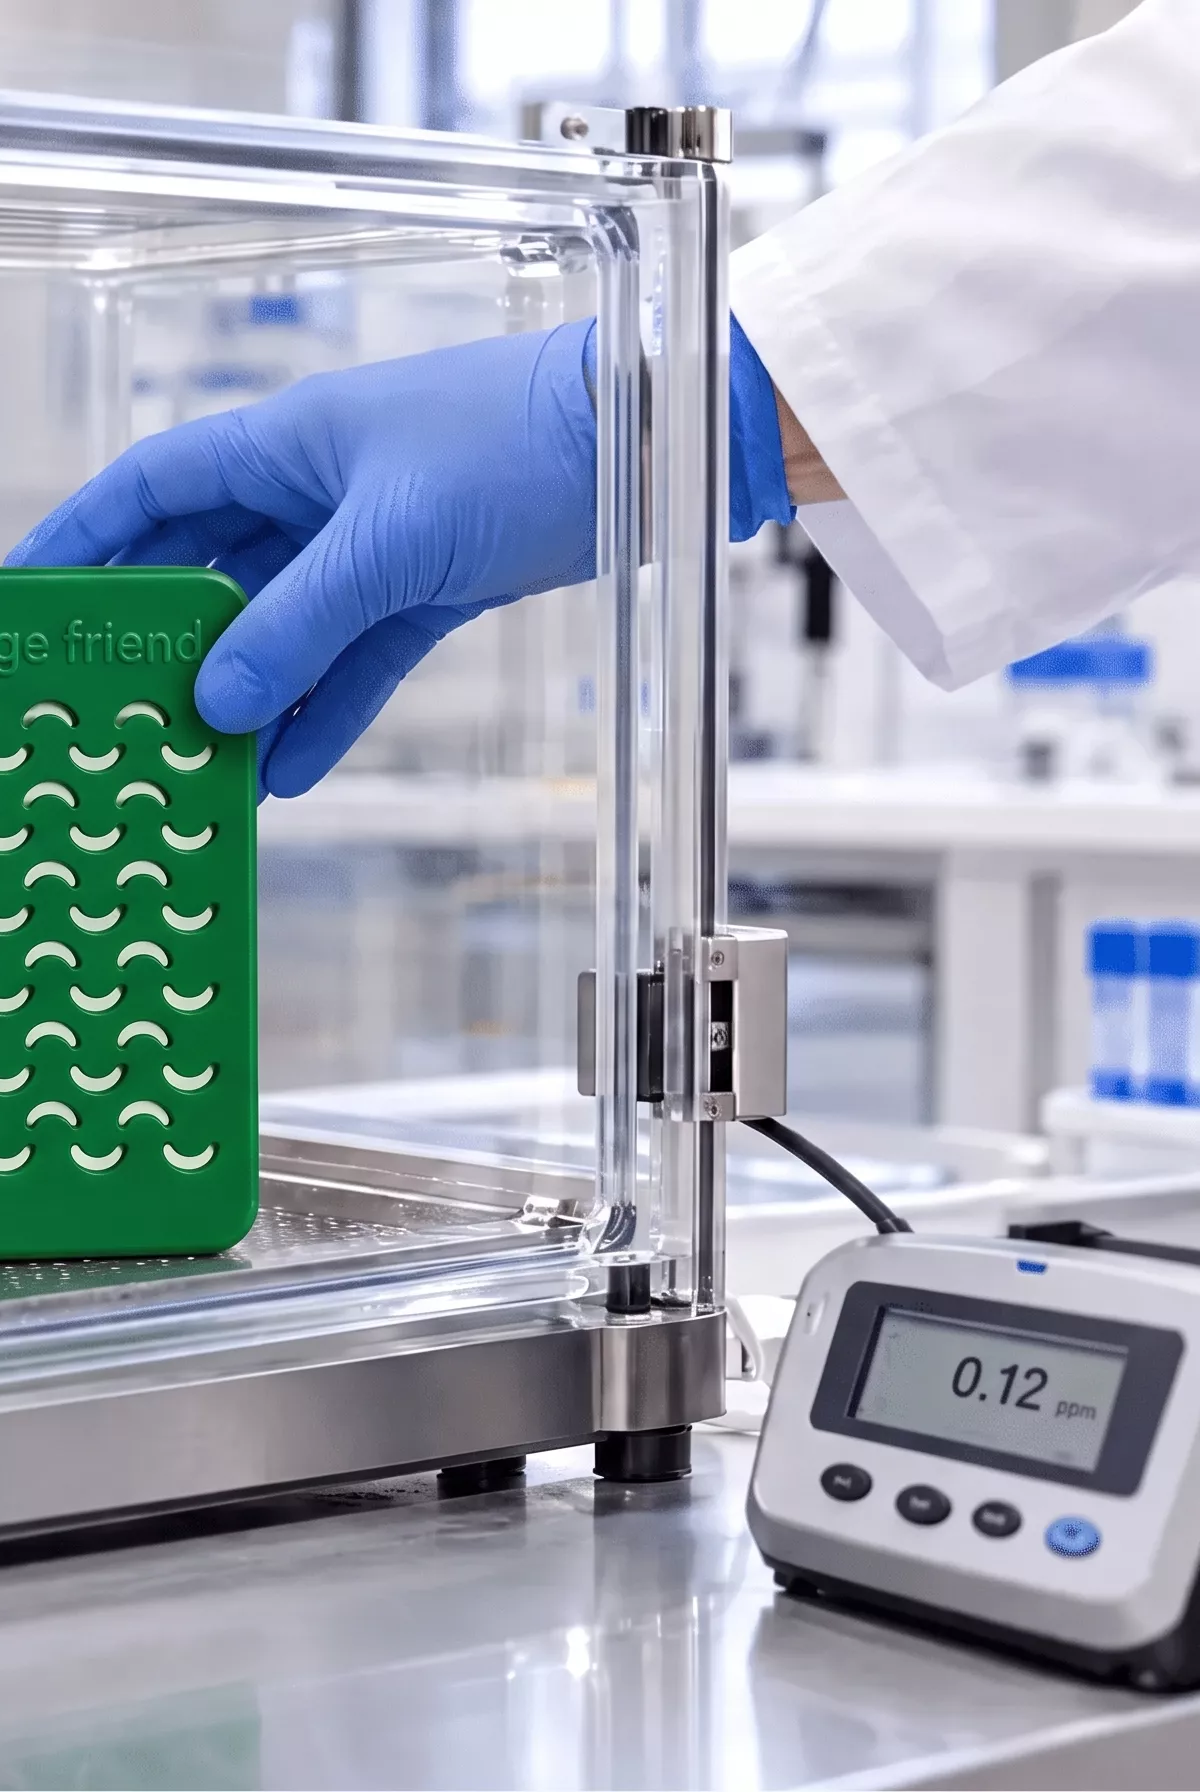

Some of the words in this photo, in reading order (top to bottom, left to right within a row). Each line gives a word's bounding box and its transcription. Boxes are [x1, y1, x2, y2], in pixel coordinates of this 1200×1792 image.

[62, 618, 201, 663] friend
[952, 1356, 1048, 1411] 0.12
[1055, 1401, 1097, 1420] ppm
